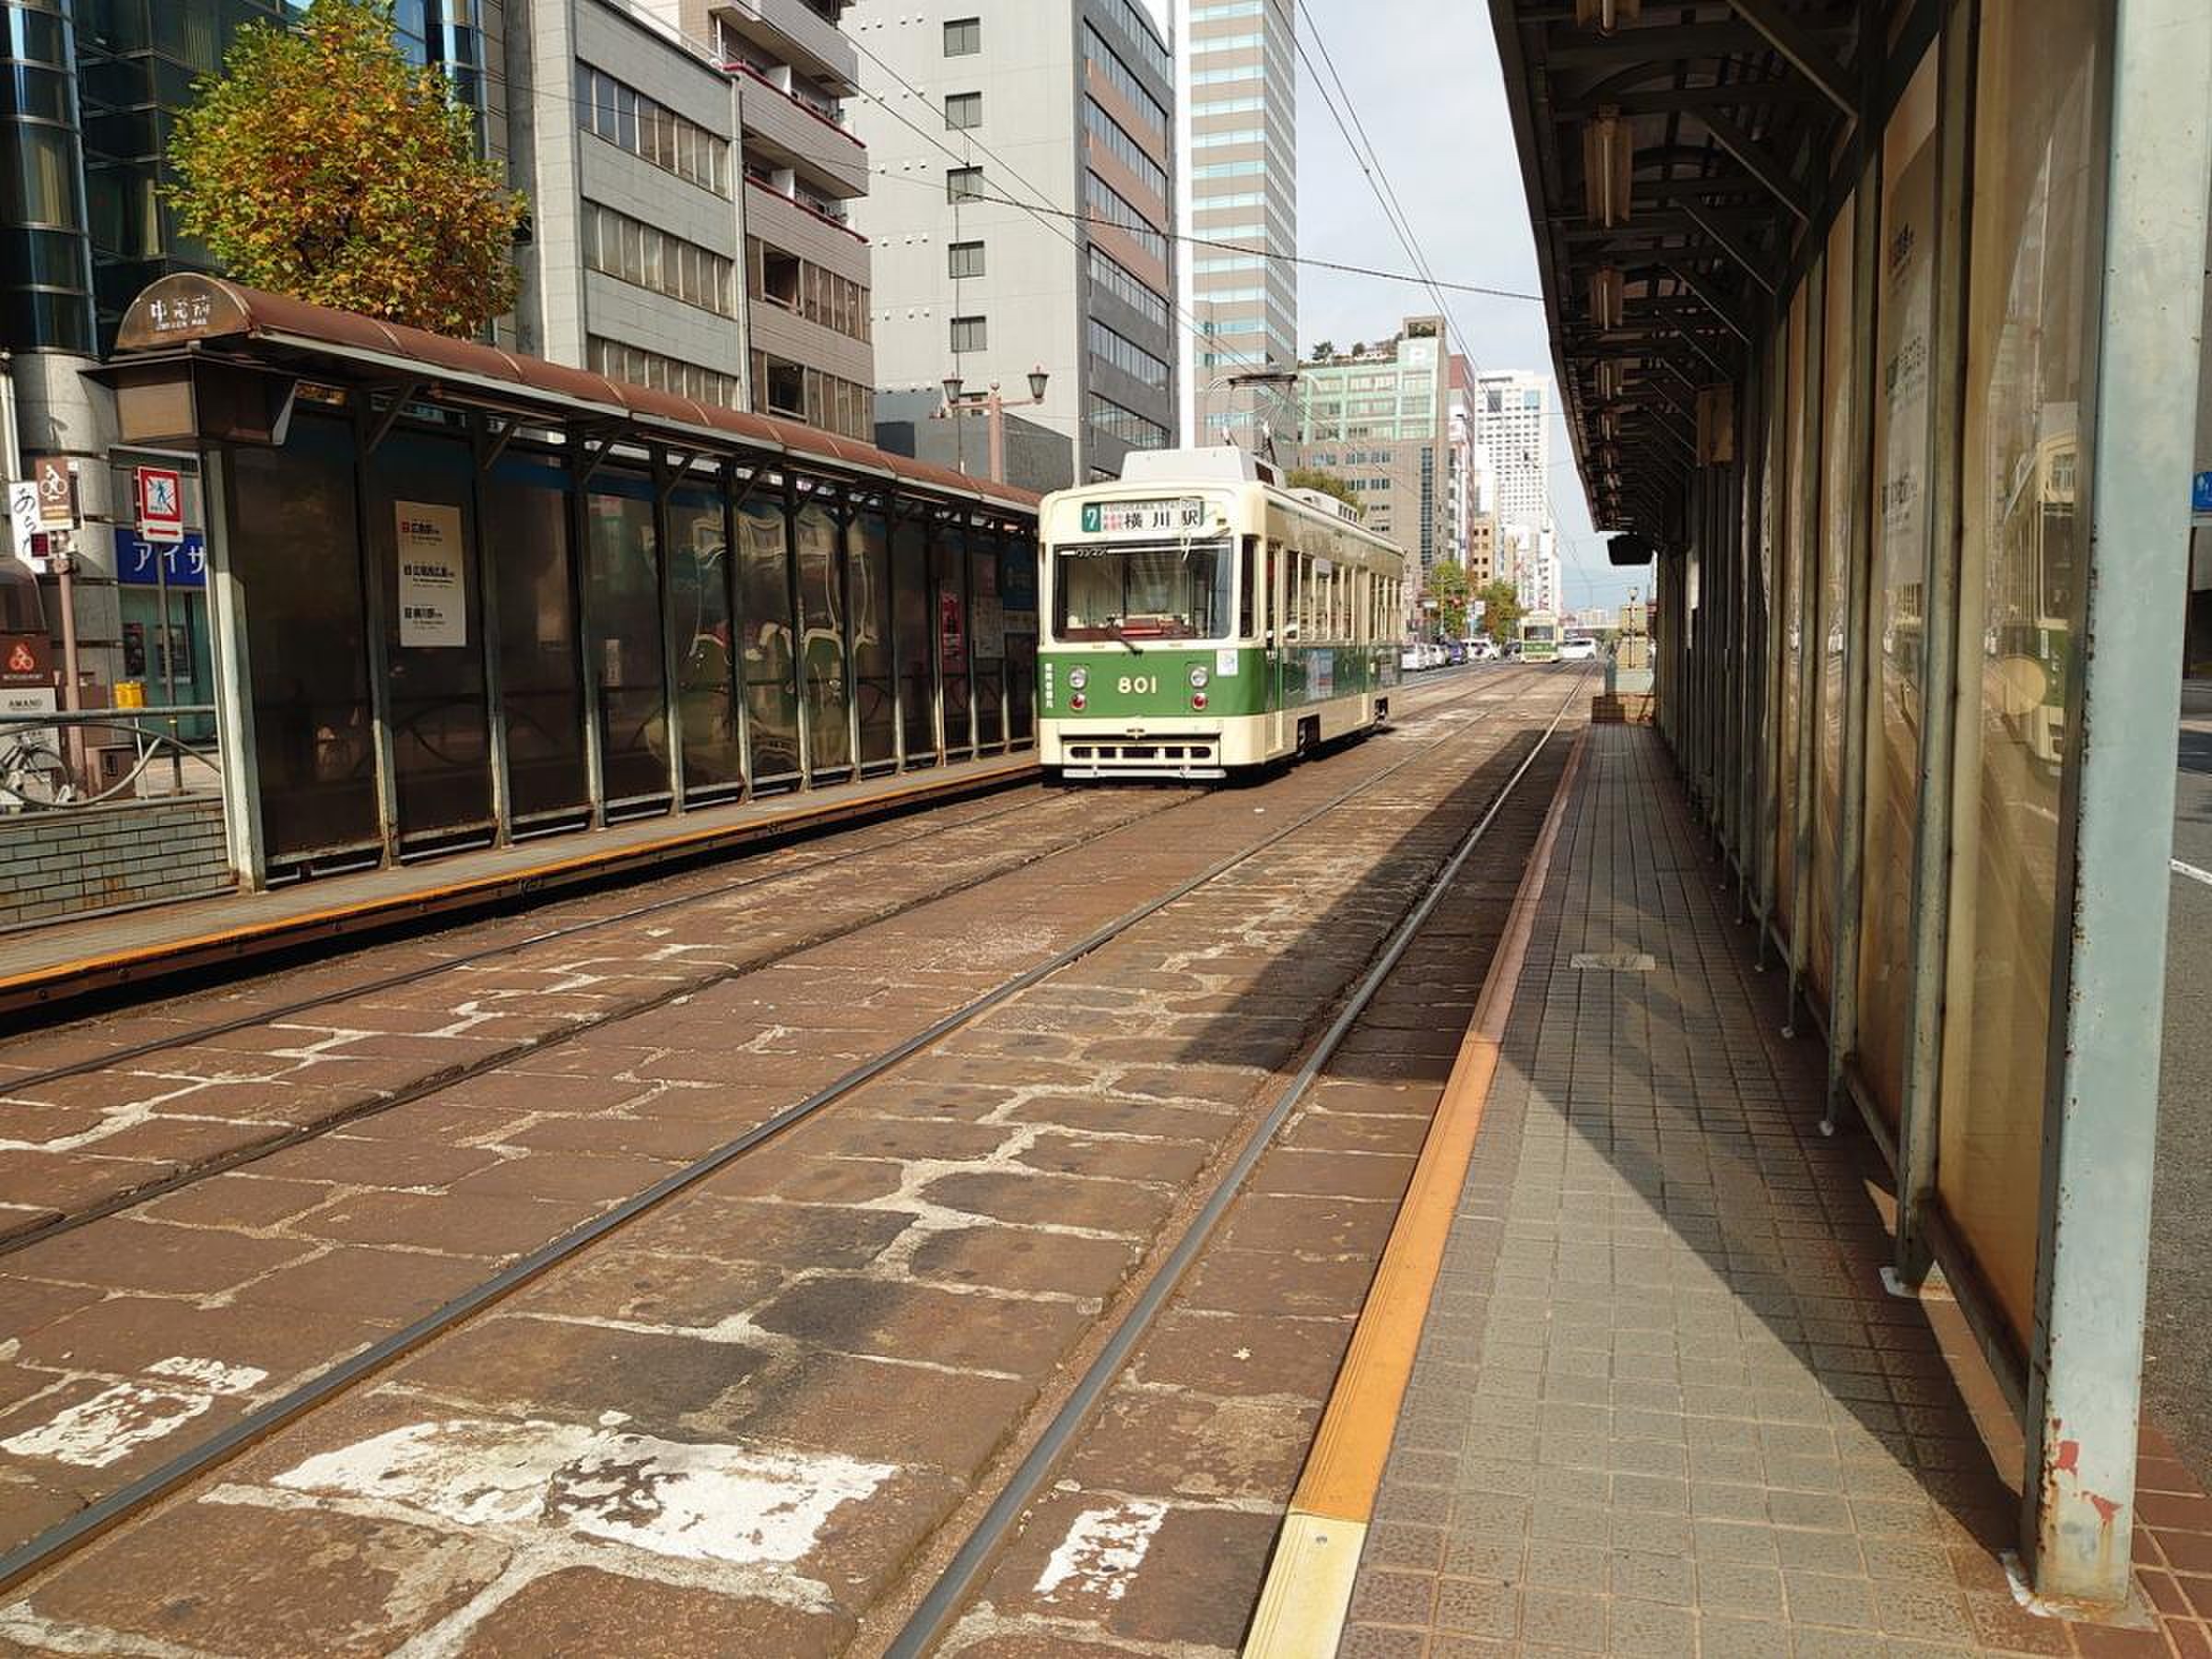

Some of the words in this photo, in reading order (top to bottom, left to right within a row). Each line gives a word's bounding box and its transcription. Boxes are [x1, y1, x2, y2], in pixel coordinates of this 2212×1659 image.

[1124, 510, 1199, 529] 横川駅
[1117, 677, 1157, 694] 801
